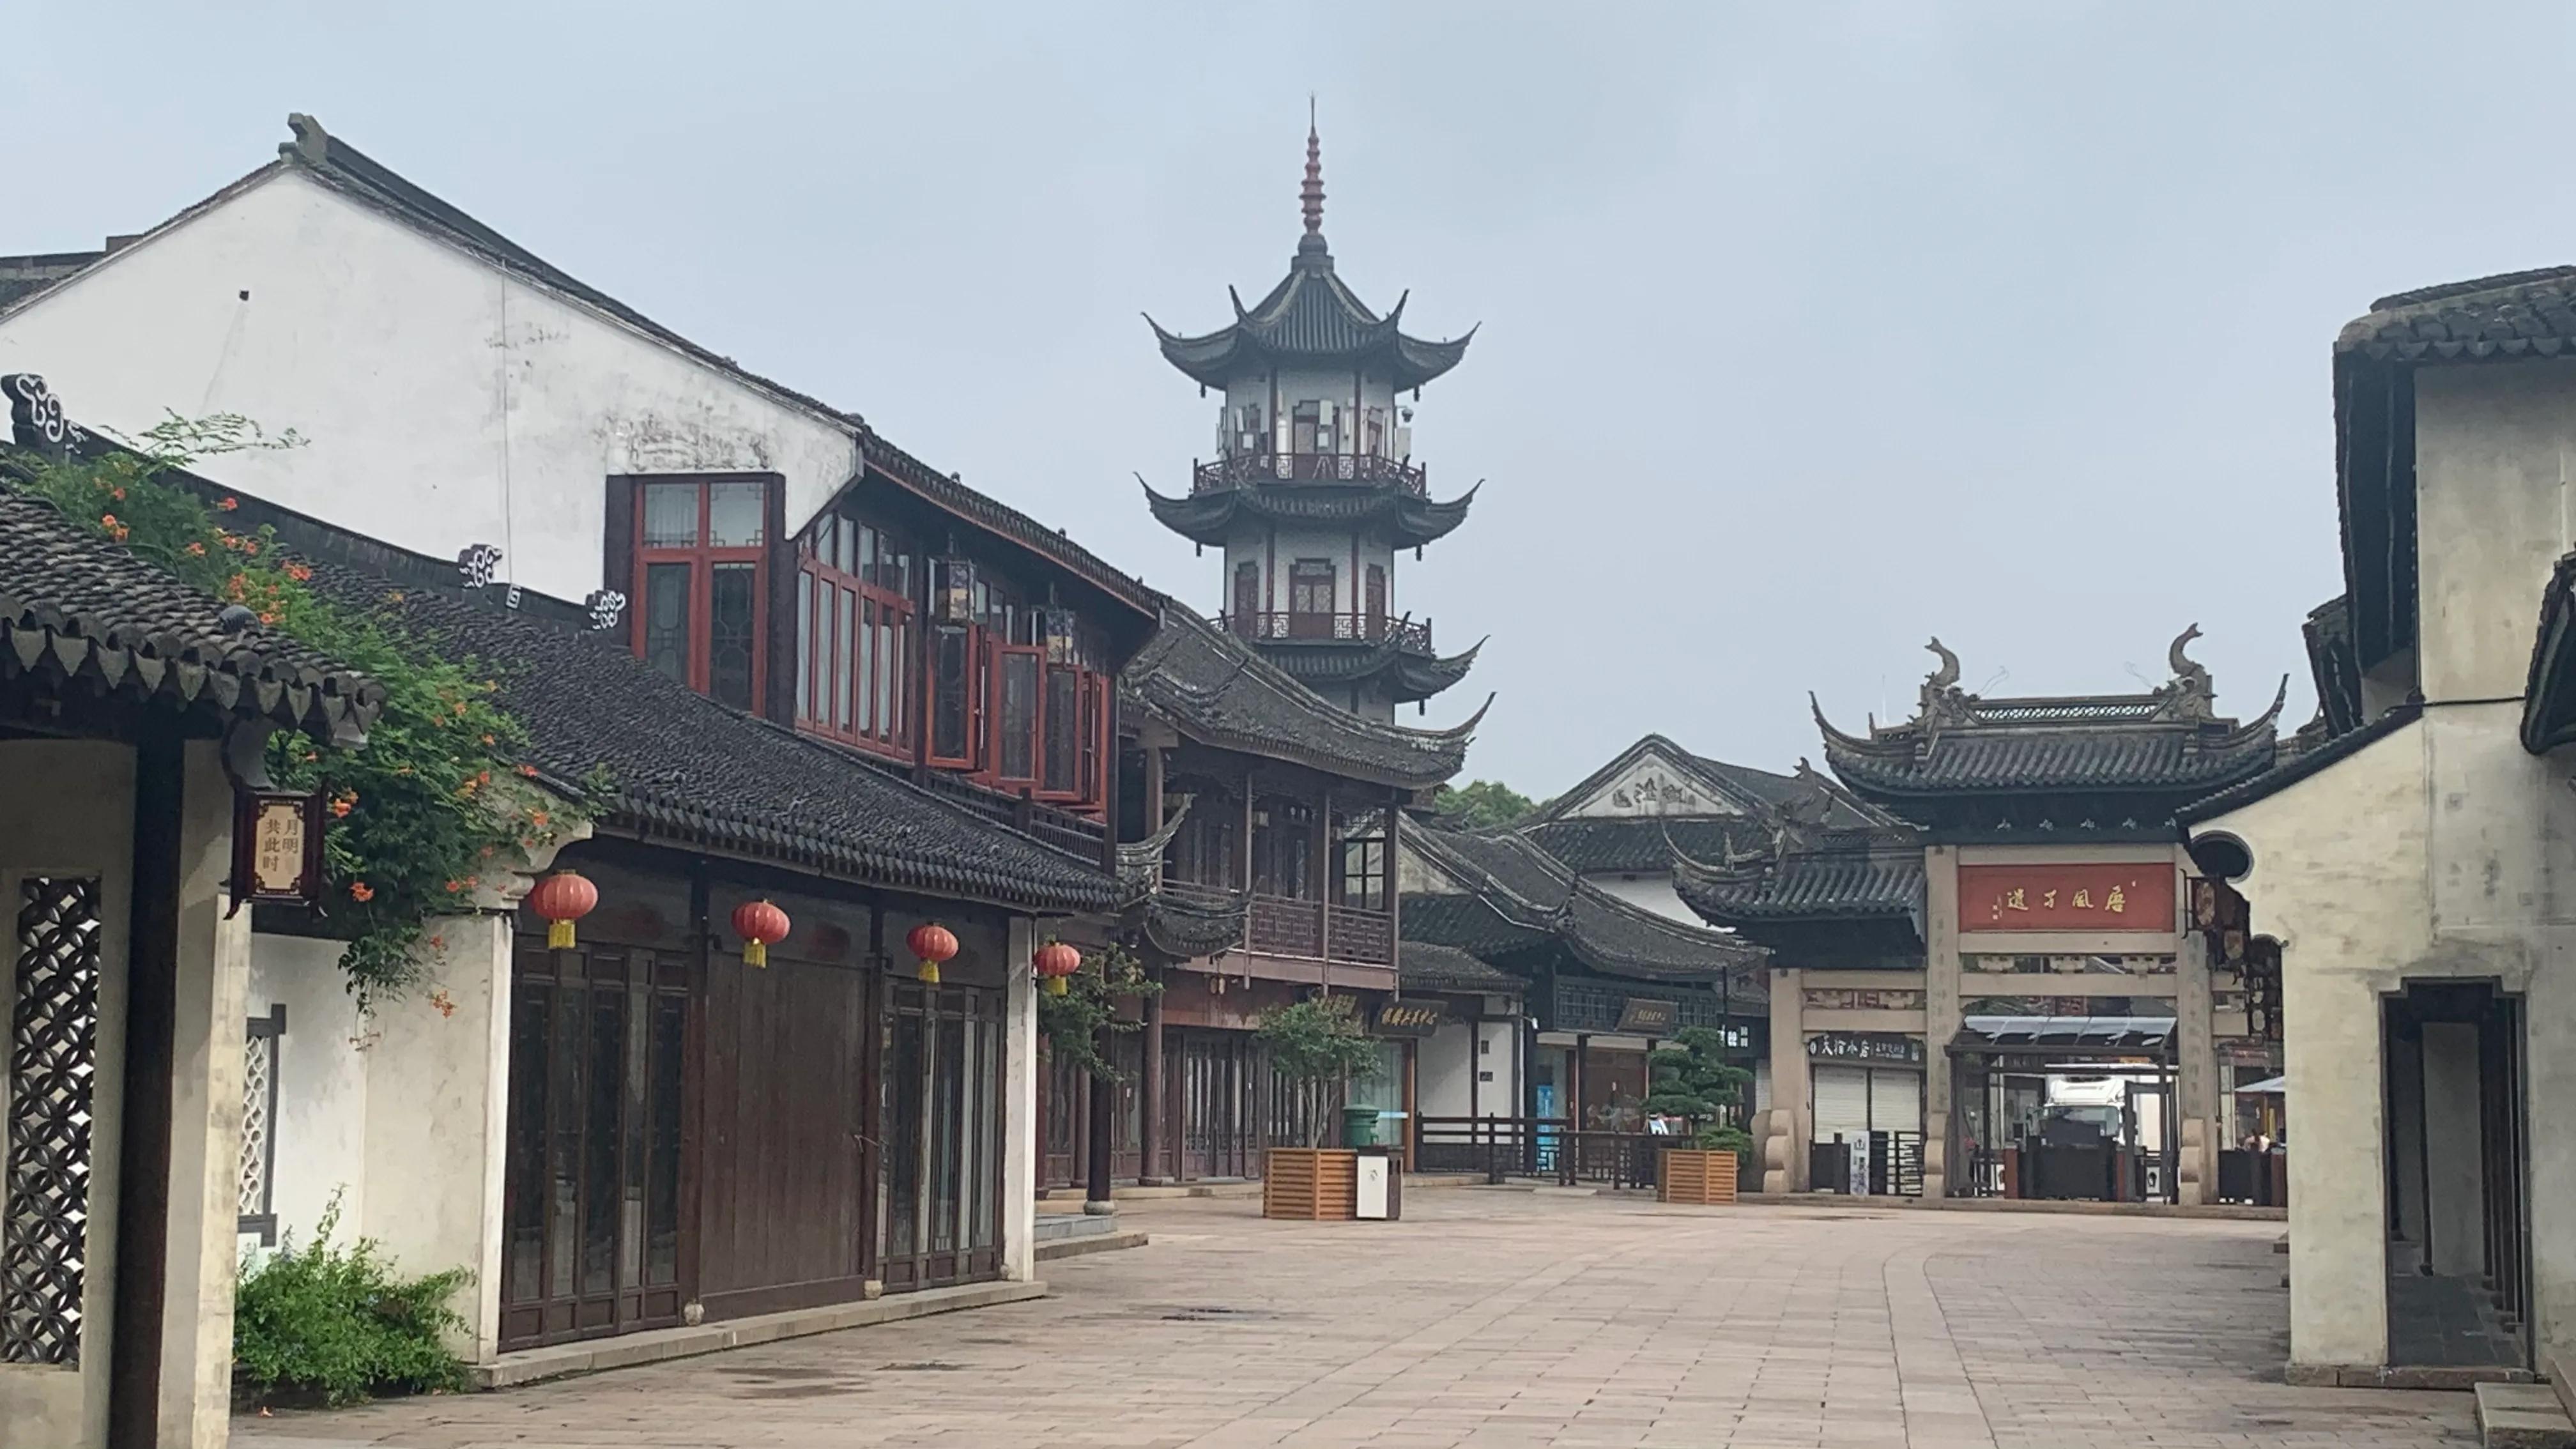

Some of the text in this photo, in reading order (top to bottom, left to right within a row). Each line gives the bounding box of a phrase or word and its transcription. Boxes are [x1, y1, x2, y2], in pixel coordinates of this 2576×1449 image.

[263, 819, 281, 872] 共此时
[282, 819, 299, 854] 月明
